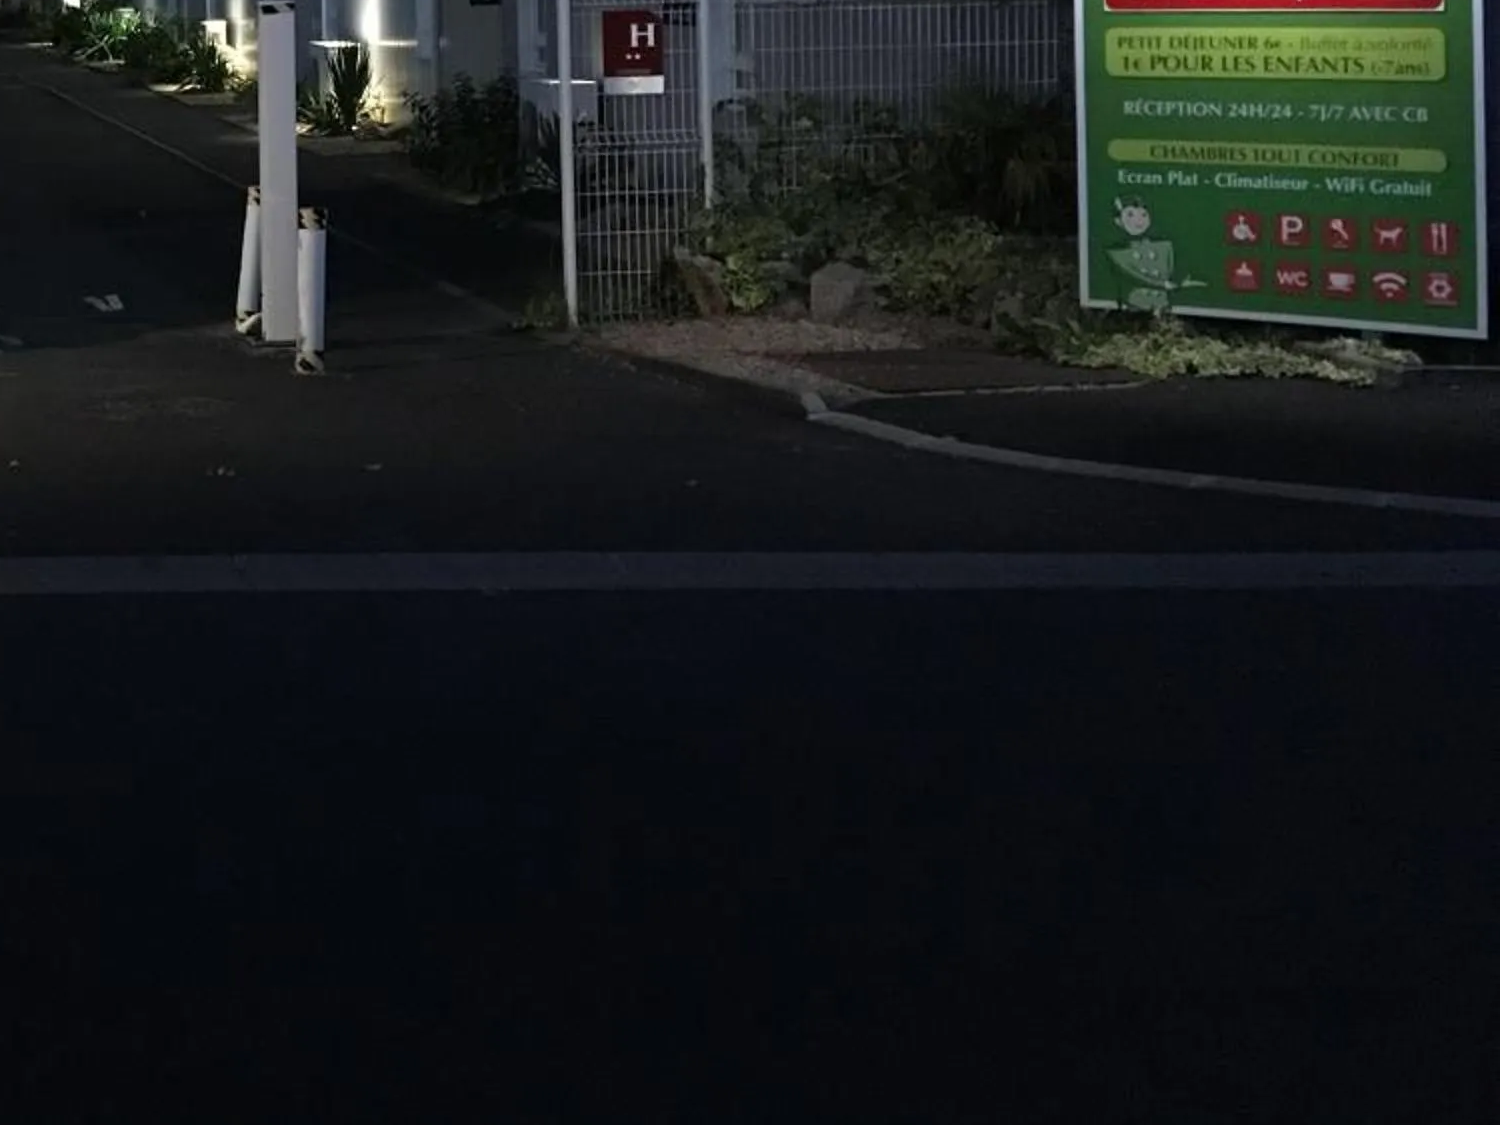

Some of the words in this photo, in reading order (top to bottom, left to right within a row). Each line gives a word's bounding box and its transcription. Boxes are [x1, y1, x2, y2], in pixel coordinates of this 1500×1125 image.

[629, 22, 655, 47] H
[1117, 35, 1162, 50] PETIT
[1169, 33, 1259, 51] DÉJEUNER
[1150, 54, 1214, 73] POUR
[1221, 54, 1258, 73] LES
[1263, 55, 1365, 74] ENFANTS
[1123, 97, 1223, 117] RÉCEPTION
[1228, 101, 1292, 119] 24H/24
[1349, 105, 1398, 122] AVEC
[1402, 106, 1429, 123] CB
[1150, 144, 1248, 162] CHAMBRES
[1252, 147, 1300, 163] TOUT
[1308, 149, 1400, 168] CONFORT
[1168, 171, 1199, 187] Plat
[1214, 171, 1309, 191] Climatiseur
[1369, 178, 1433, 198] Gratuit
[1280, 215, 1304, 243] P
[1276, 269, 1309, 287] WC
